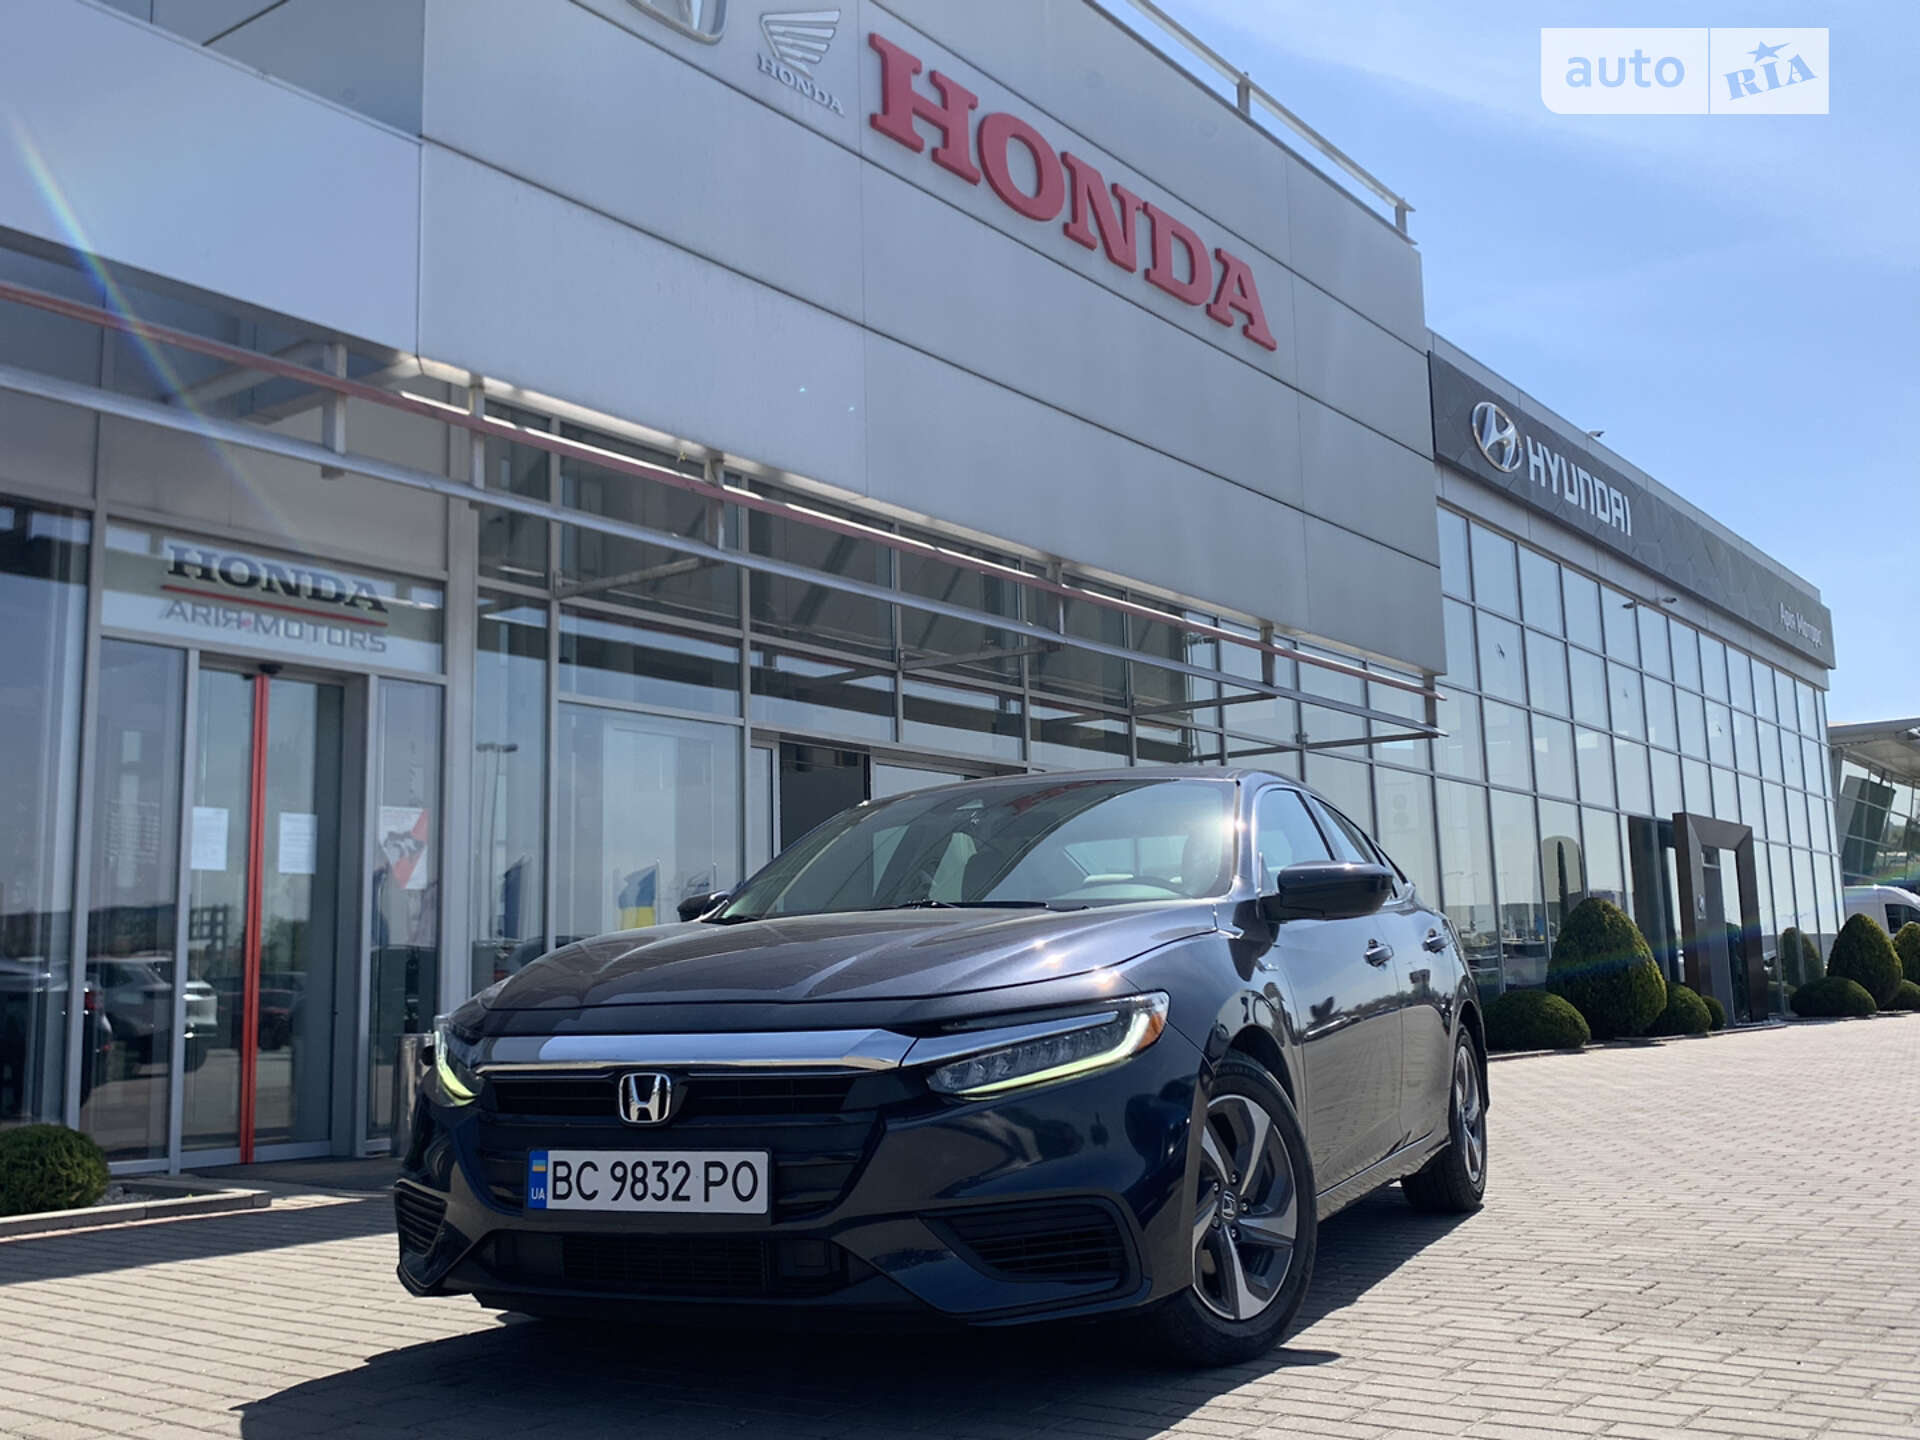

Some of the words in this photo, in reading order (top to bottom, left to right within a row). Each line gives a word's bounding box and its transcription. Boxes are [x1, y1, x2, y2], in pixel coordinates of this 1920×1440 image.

[757, 53, 845, 118] HONDA
[868, 32, 1278, 352] HONDA
[1526, 435, 1632, 537] HYUNDAI
[167, 545, 389, 614] HONDA
[531, 1187, 545, 1200] UA
[552, 1160, 599, 1201] BC
[610, 1160, 691, 1202] 9832
[703, 1160, 758, 1203] PO
